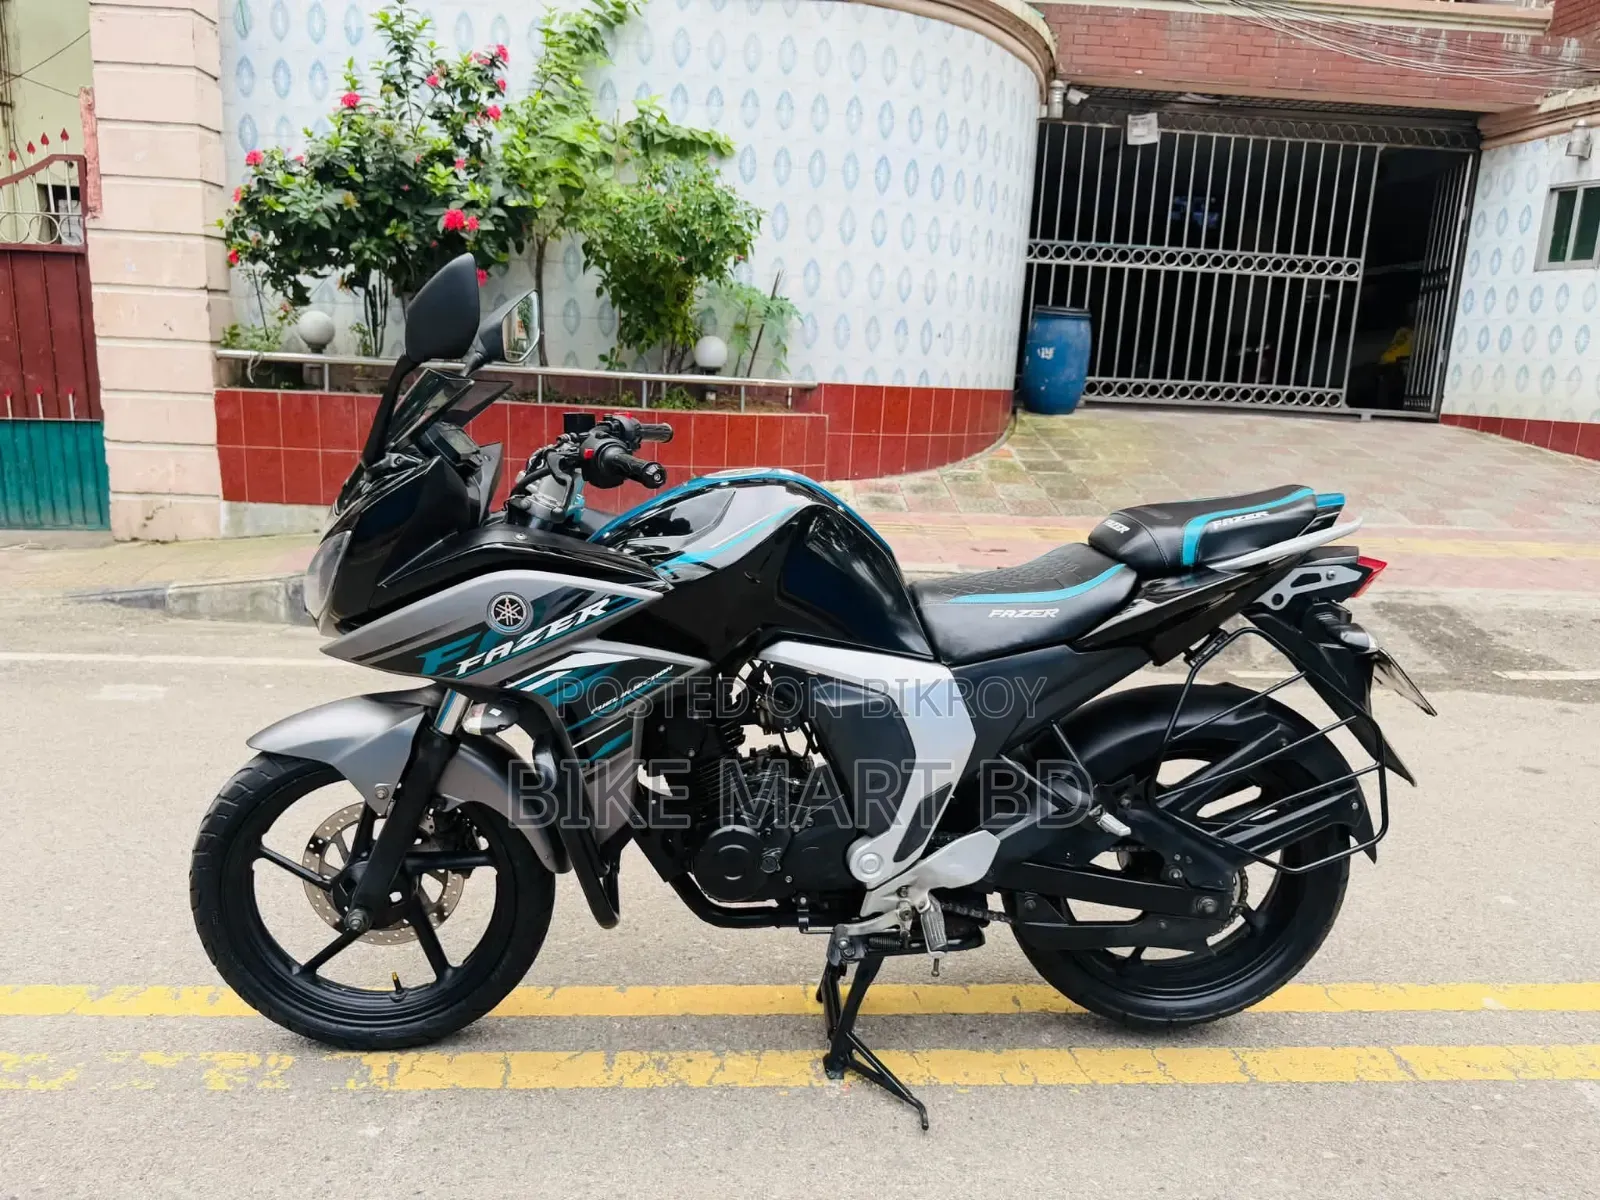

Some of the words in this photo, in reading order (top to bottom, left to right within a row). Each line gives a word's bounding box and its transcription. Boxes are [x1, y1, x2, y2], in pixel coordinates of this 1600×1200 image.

[1211, 511, 1270, 529] FAZER
[988, 608, 1060, 619] FAZER
[456, 598, 610, 676] FAZER
